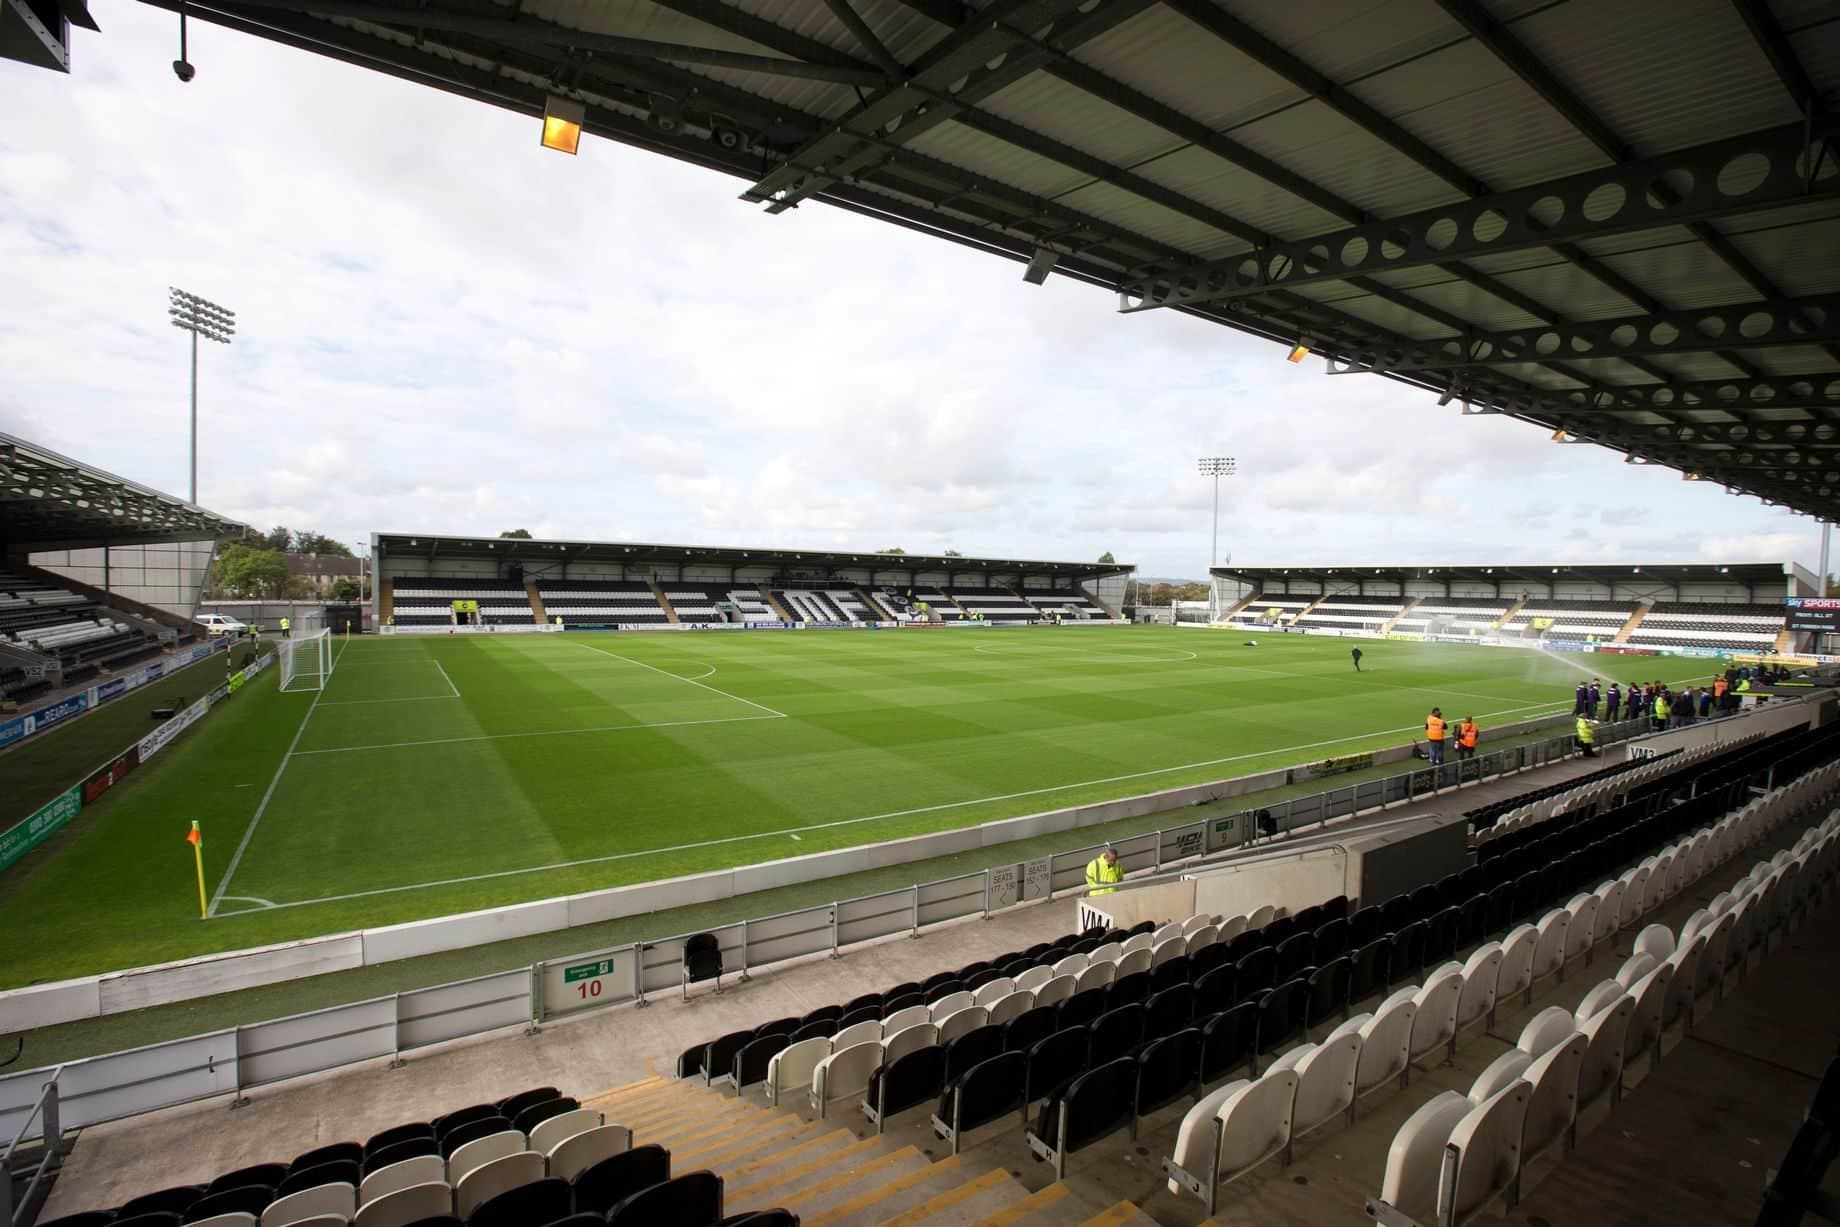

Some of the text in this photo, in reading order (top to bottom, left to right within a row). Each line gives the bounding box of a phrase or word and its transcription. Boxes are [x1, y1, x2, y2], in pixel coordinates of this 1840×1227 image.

[1804, 599, 1840, 608] SPORTS
[993, 872, 1013, 884] SEATS
[578, 980, 602, 999] 10
[1047, 1149, 1052, 1160] H
[1192, 1183, 1199, 1192] J
